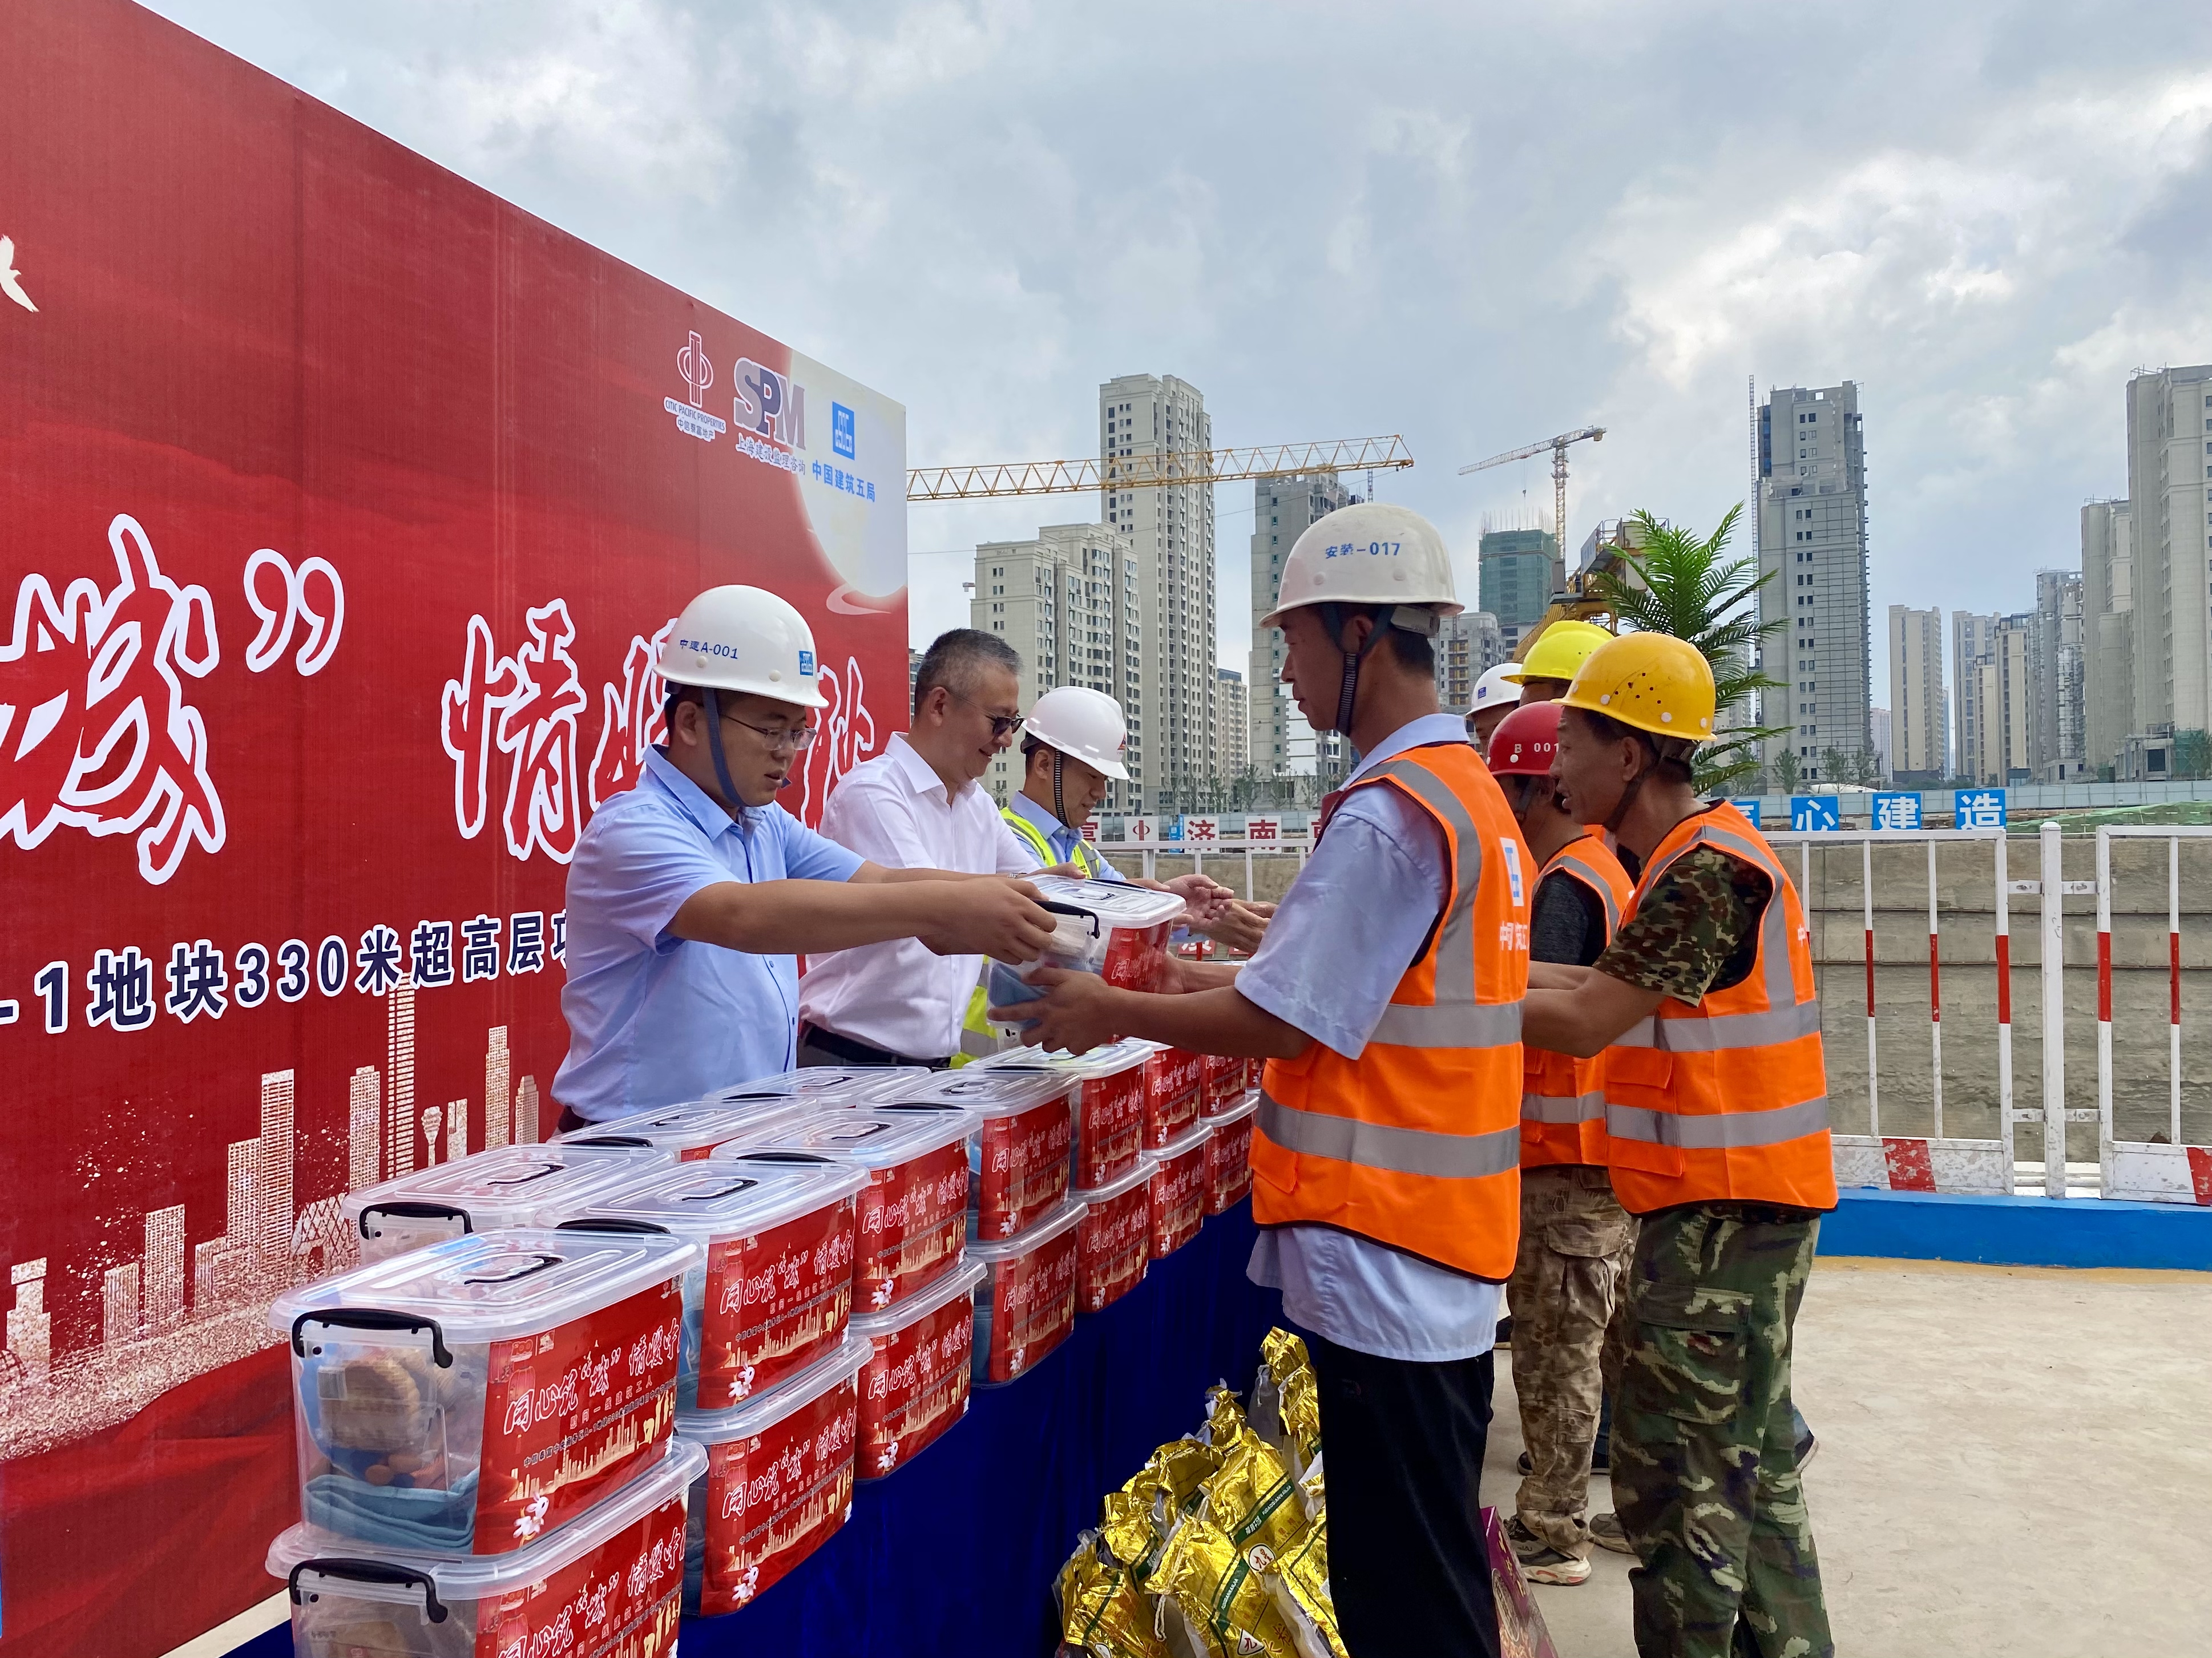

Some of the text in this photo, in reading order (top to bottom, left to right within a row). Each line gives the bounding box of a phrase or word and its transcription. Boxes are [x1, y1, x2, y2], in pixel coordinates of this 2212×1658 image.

[665, 400, 725, 431] CITIC PACIFIC PROPERTIES
[734, 358, 806, 450] SPM
[677, 418, 714, 439] 中信泰富地产
[737, 435, 806, 475] 上海建设监理咨询
[812, 460, 875, 502] 中国建筑五局
[0, 911, 567, 1033] -1地块330米超高层
